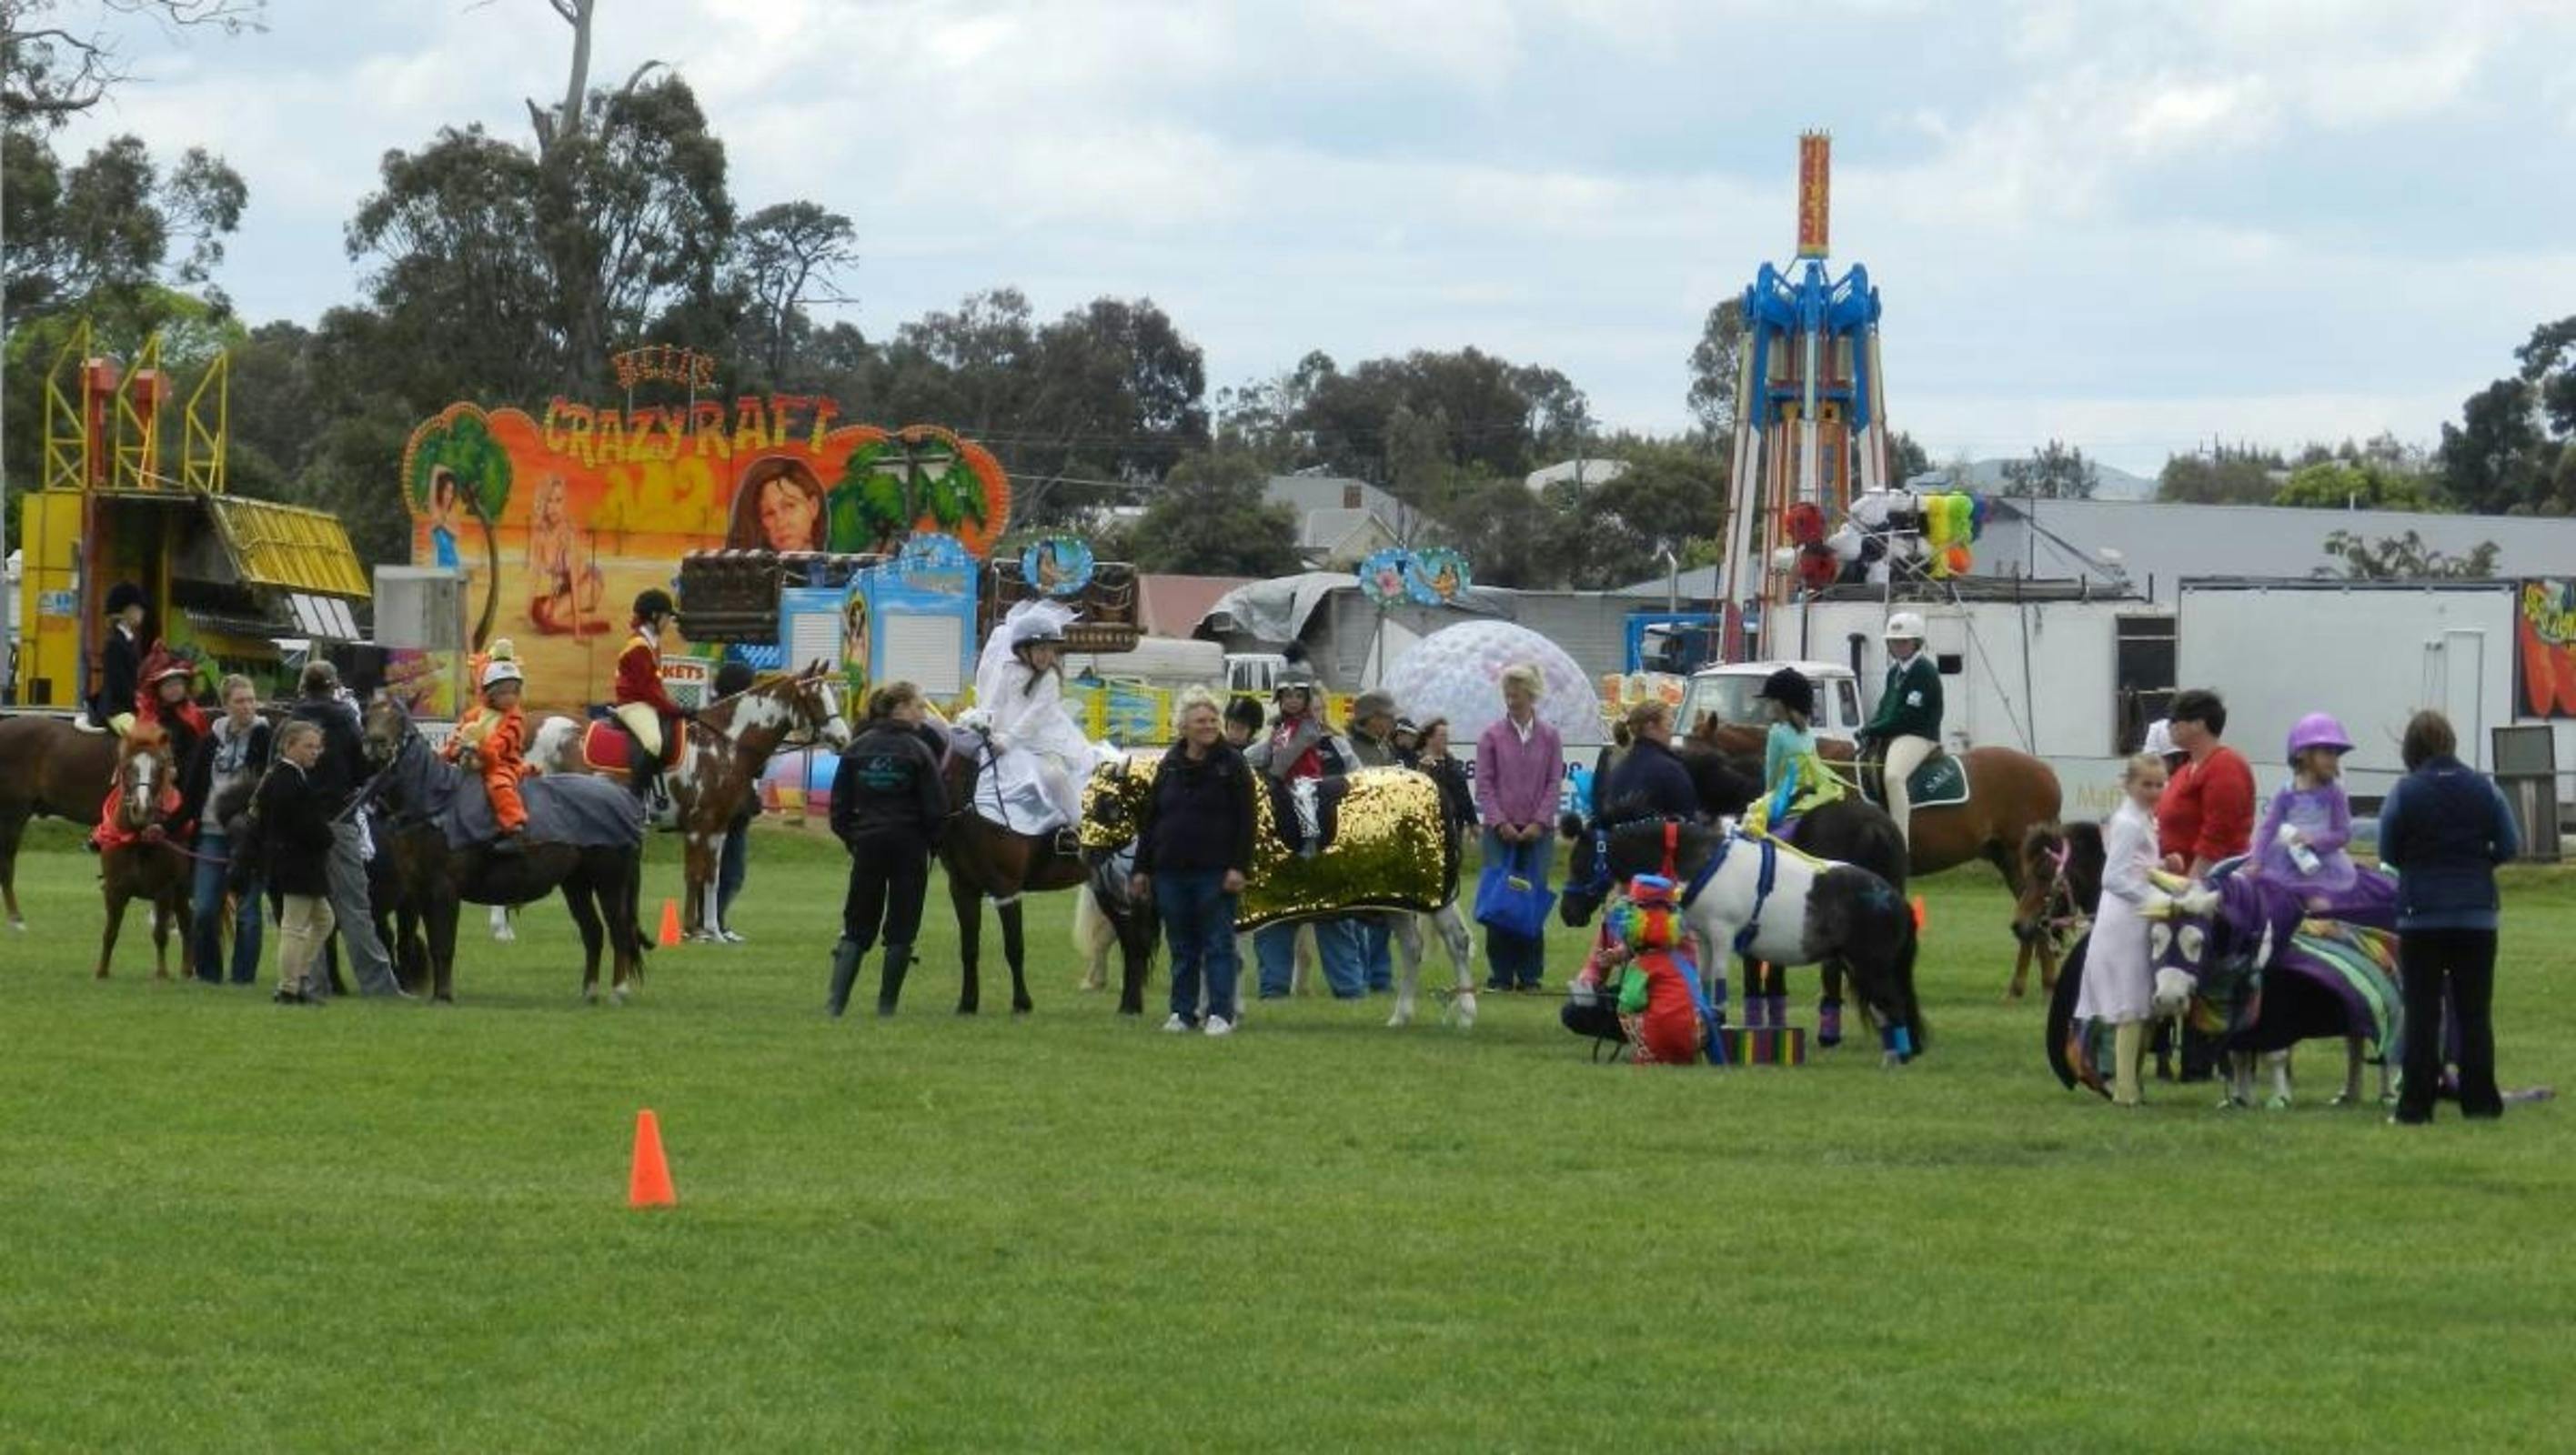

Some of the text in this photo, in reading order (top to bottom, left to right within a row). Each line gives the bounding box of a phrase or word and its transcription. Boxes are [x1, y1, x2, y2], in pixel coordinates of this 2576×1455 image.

[545, 392, 840, 469] CRAZY RAFT
[661, 664, 706, 679] KETS
